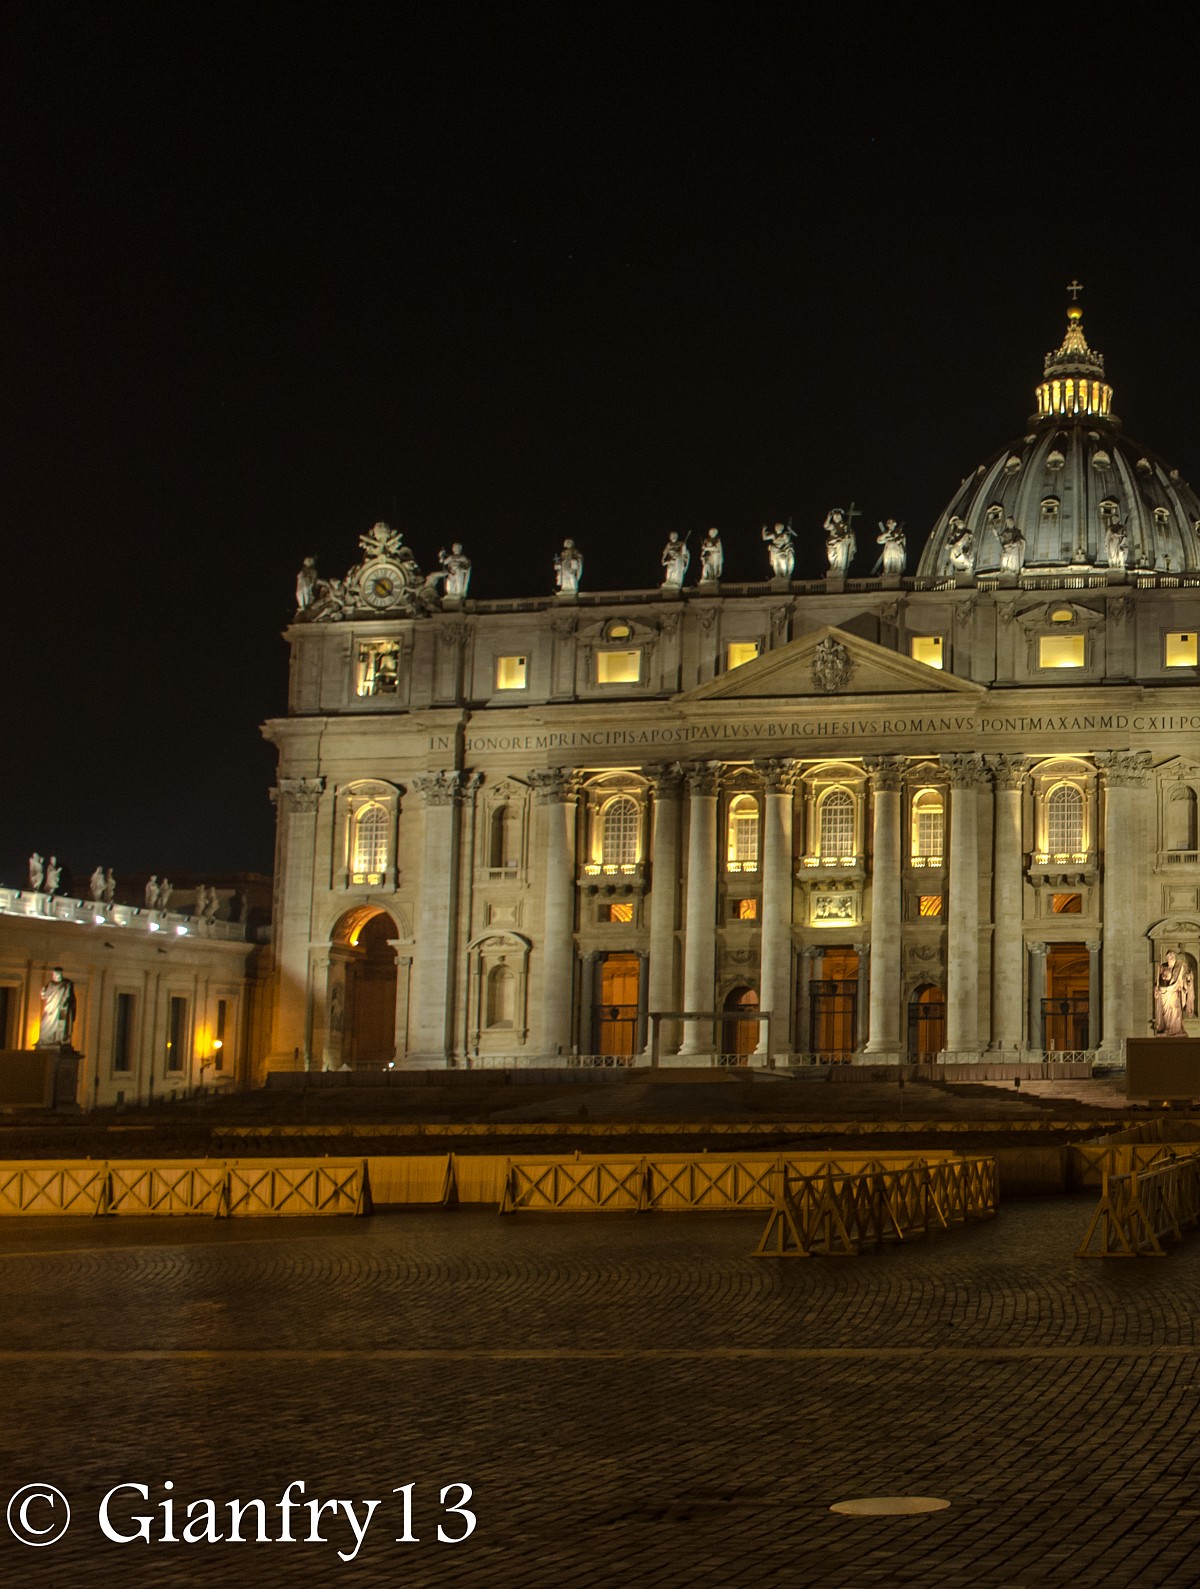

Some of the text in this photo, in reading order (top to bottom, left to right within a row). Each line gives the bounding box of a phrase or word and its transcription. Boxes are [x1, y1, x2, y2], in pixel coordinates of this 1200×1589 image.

[430, 737, 449, 750] IN
[549, 730, 635, 747] PRINCIPIS
[638, 728, 691, 744] APOST
[691, 724, 749, 739] PAVLVS
[753, 724, 763, 737] V
[768, 719, 877, 737] BVRGHESIVS
[883, 717, 974, 733] ROMANVS
[981, 717, 1028, 732] PONT
[1029, 717, 1067, 731] MAX
[1071, 715, 1095, 730] AN
